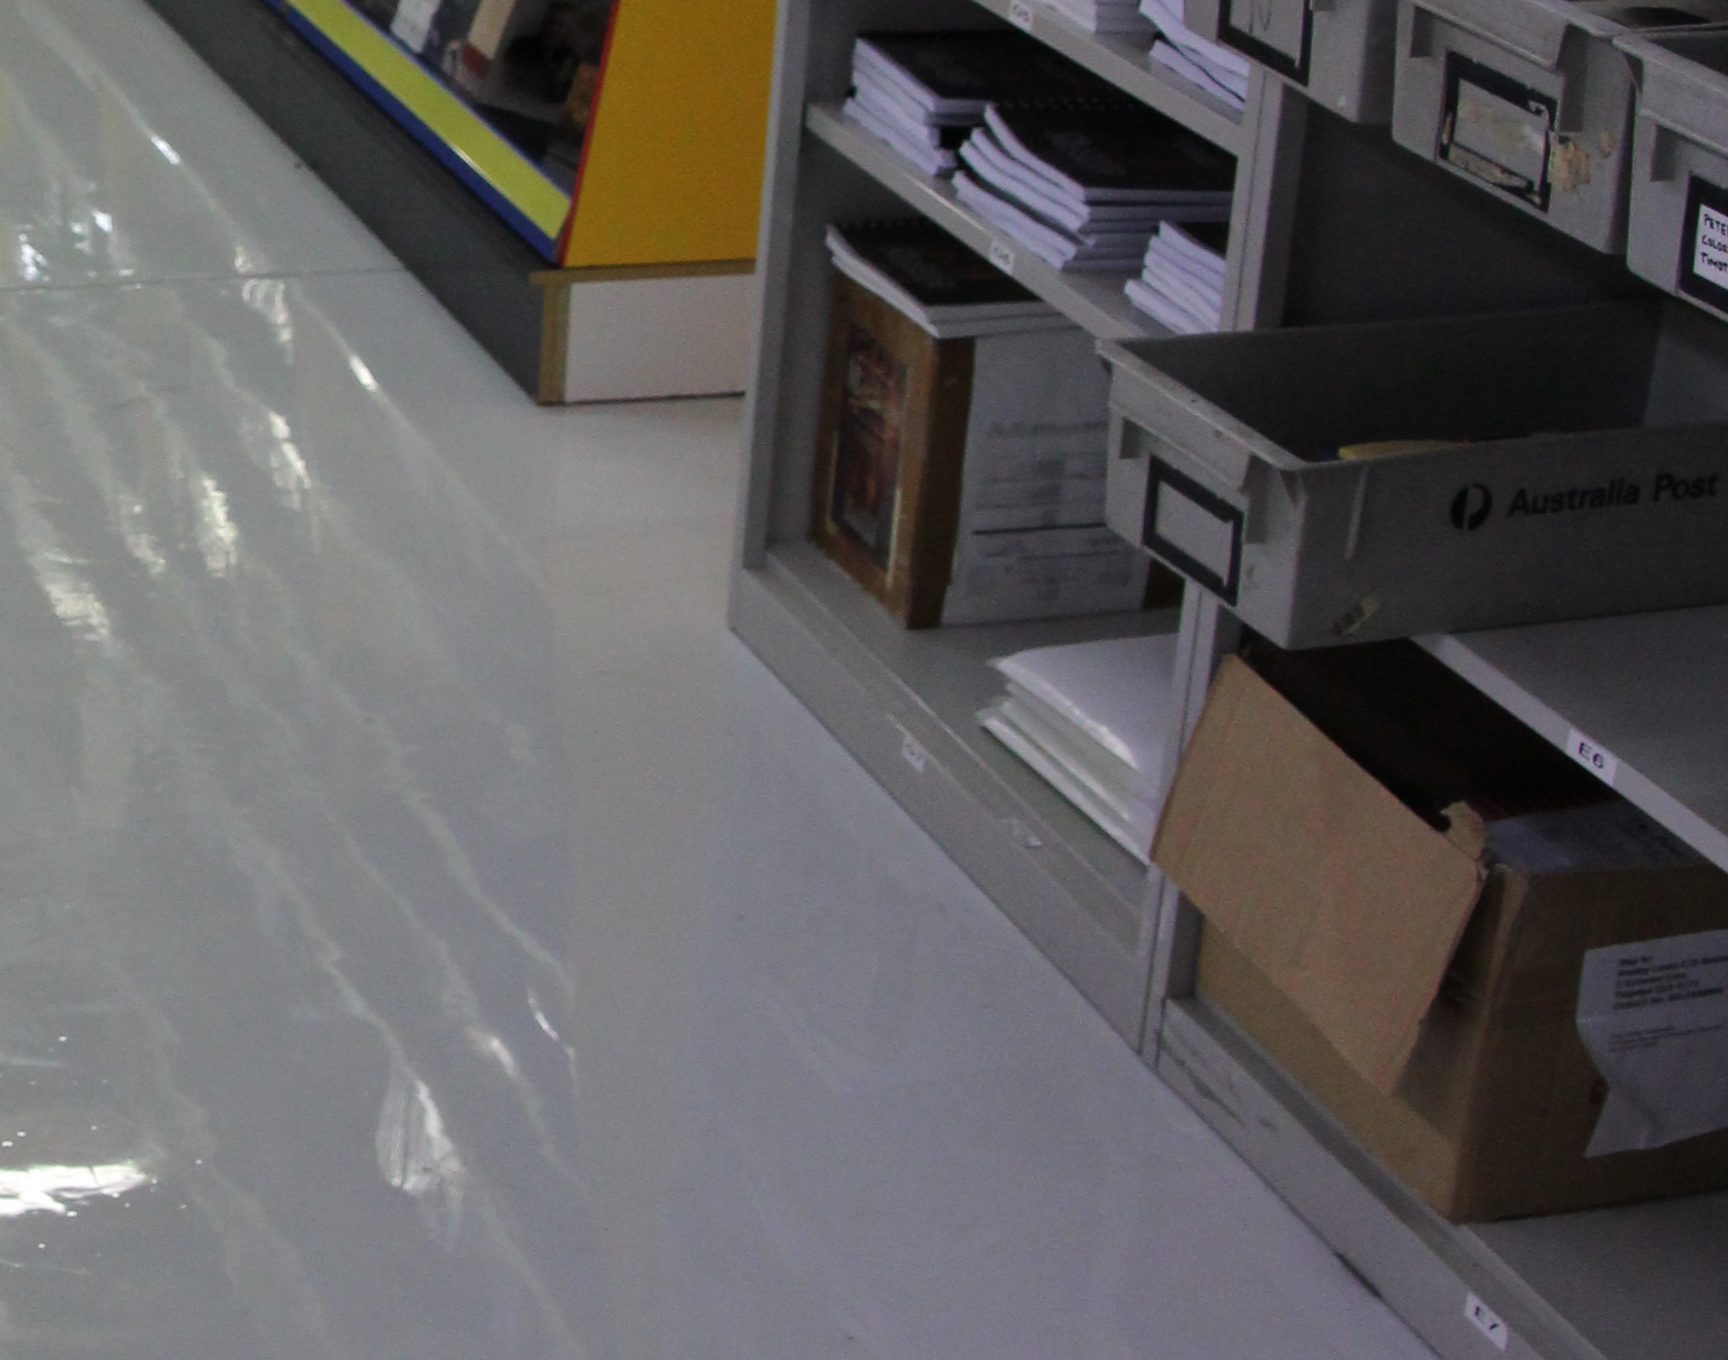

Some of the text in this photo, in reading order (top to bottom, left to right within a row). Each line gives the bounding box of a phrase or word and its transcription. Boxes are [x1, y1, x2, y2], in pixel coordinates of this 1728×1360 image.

[1704, 213, 1728, 237] PETE
[1506, 472, 1720, 518] Australia Post
[1577, 740, 1607, 770] E6
